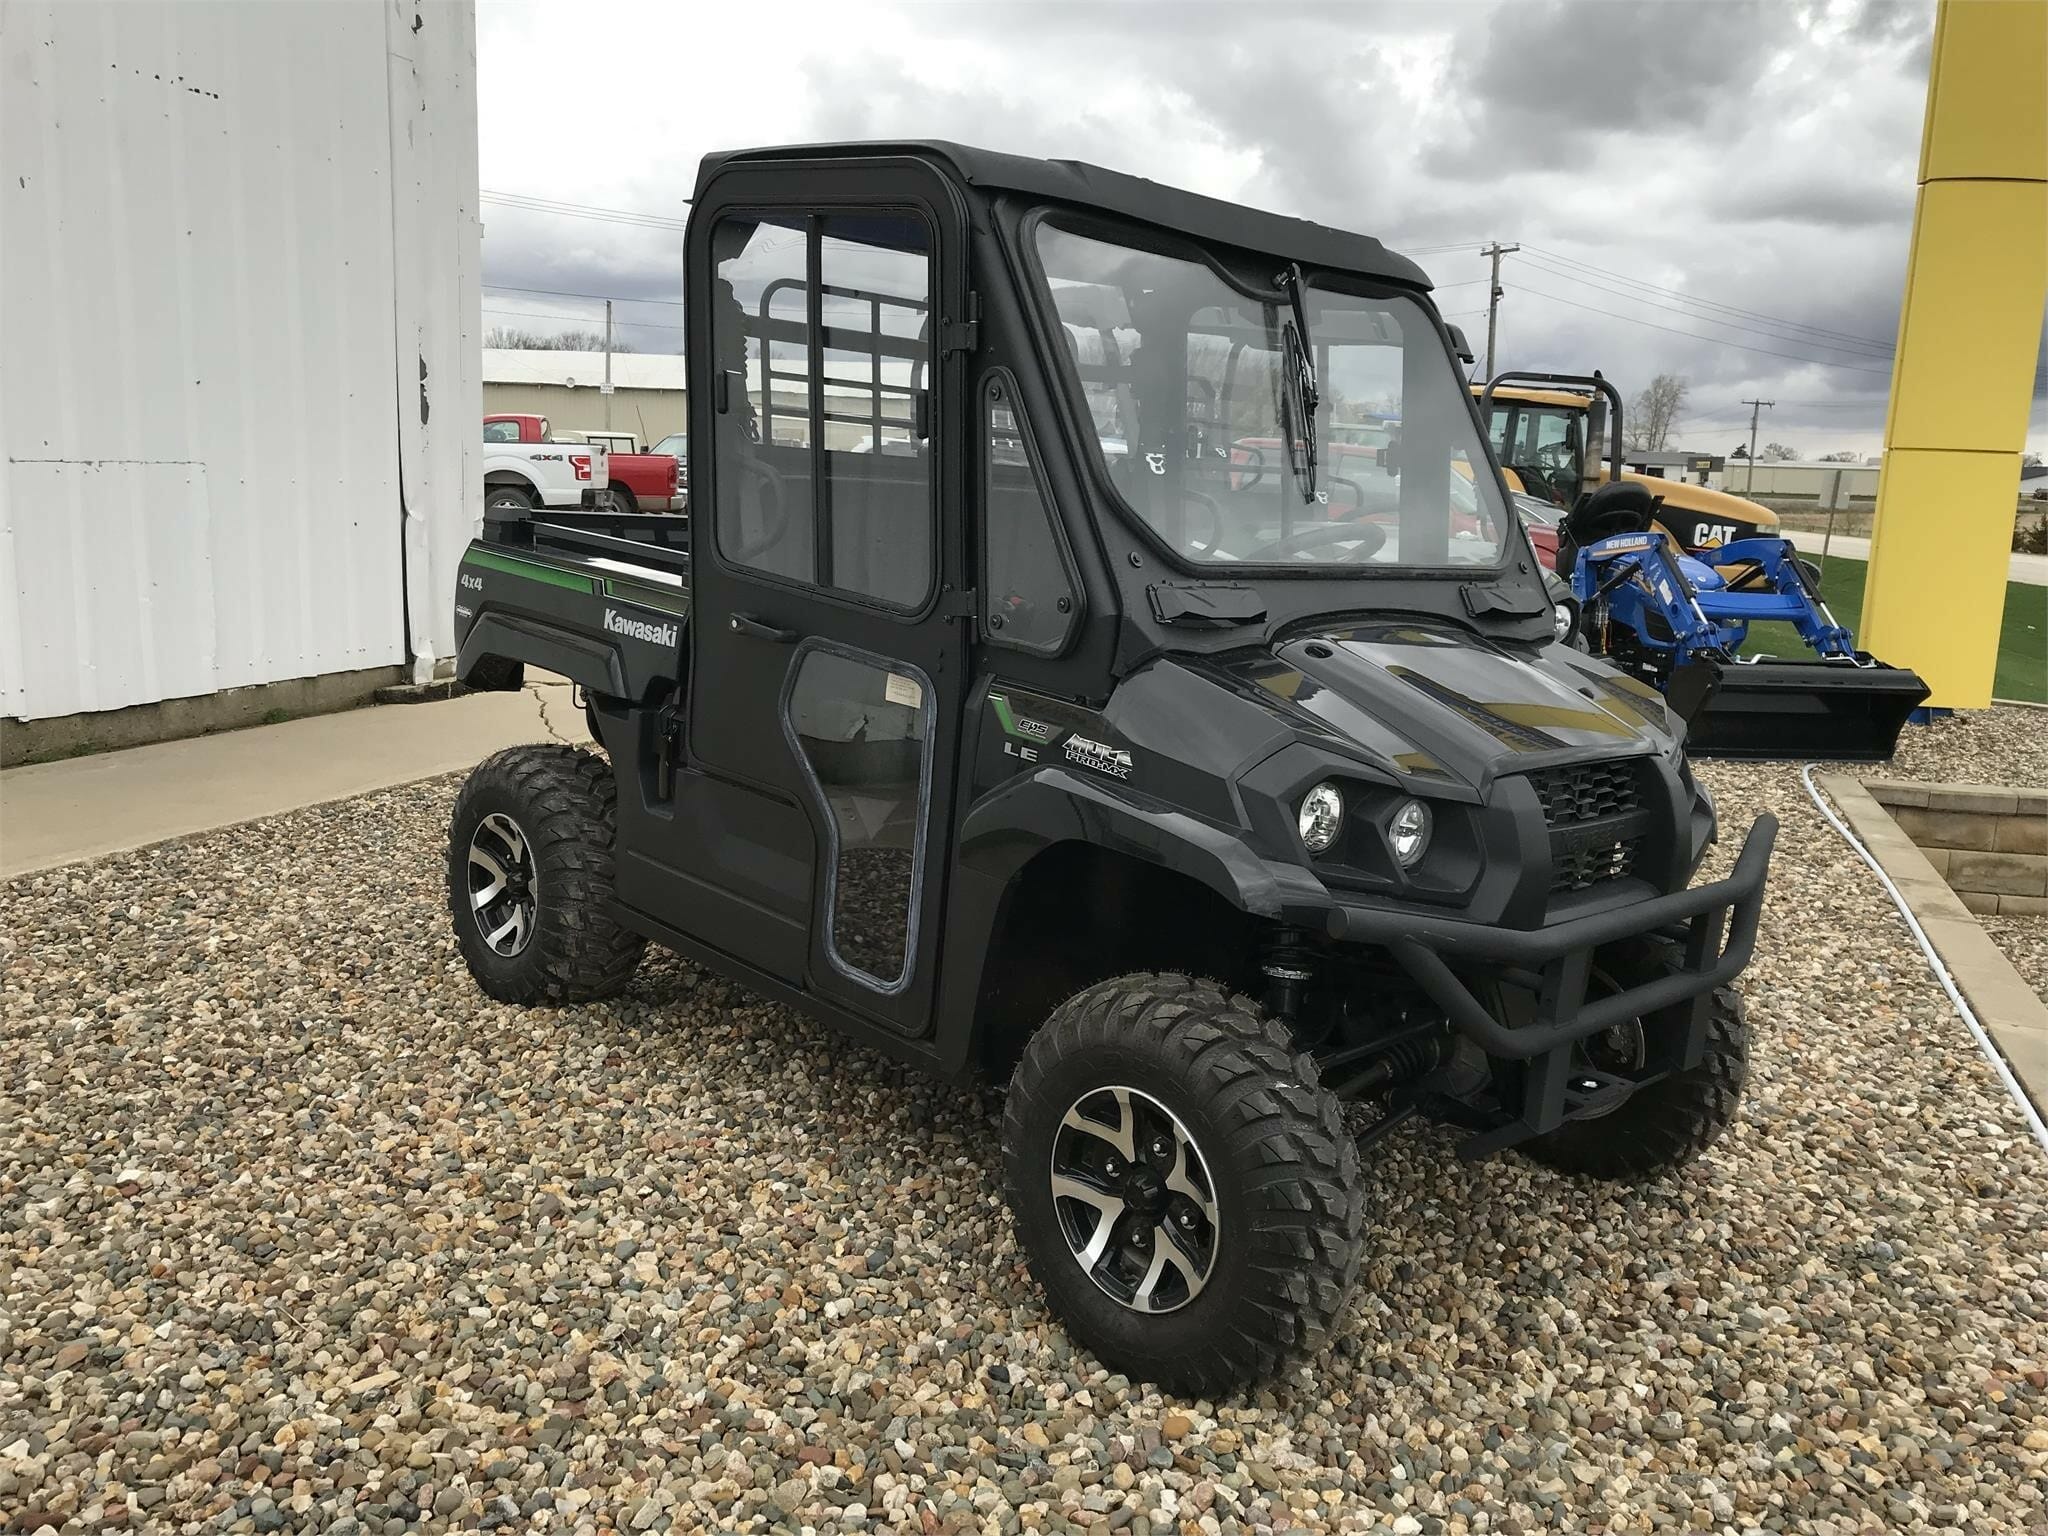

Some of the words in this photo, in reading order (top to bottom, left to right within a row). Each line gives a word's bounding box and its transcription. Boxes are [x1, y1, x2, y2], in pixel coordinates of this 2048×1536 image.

[1606, 540, 1620, 549] NEW
[1621, 536, 1648, 548] HOLLAND
[1694, 523, 1737, 546] CAT
[461, 574, 483, 591] 4x4
[603, 608, 678, 648] Kawasaki
[1004, 742, 1038, 762] LE
[1062, 733, 1133, 767] MULE
